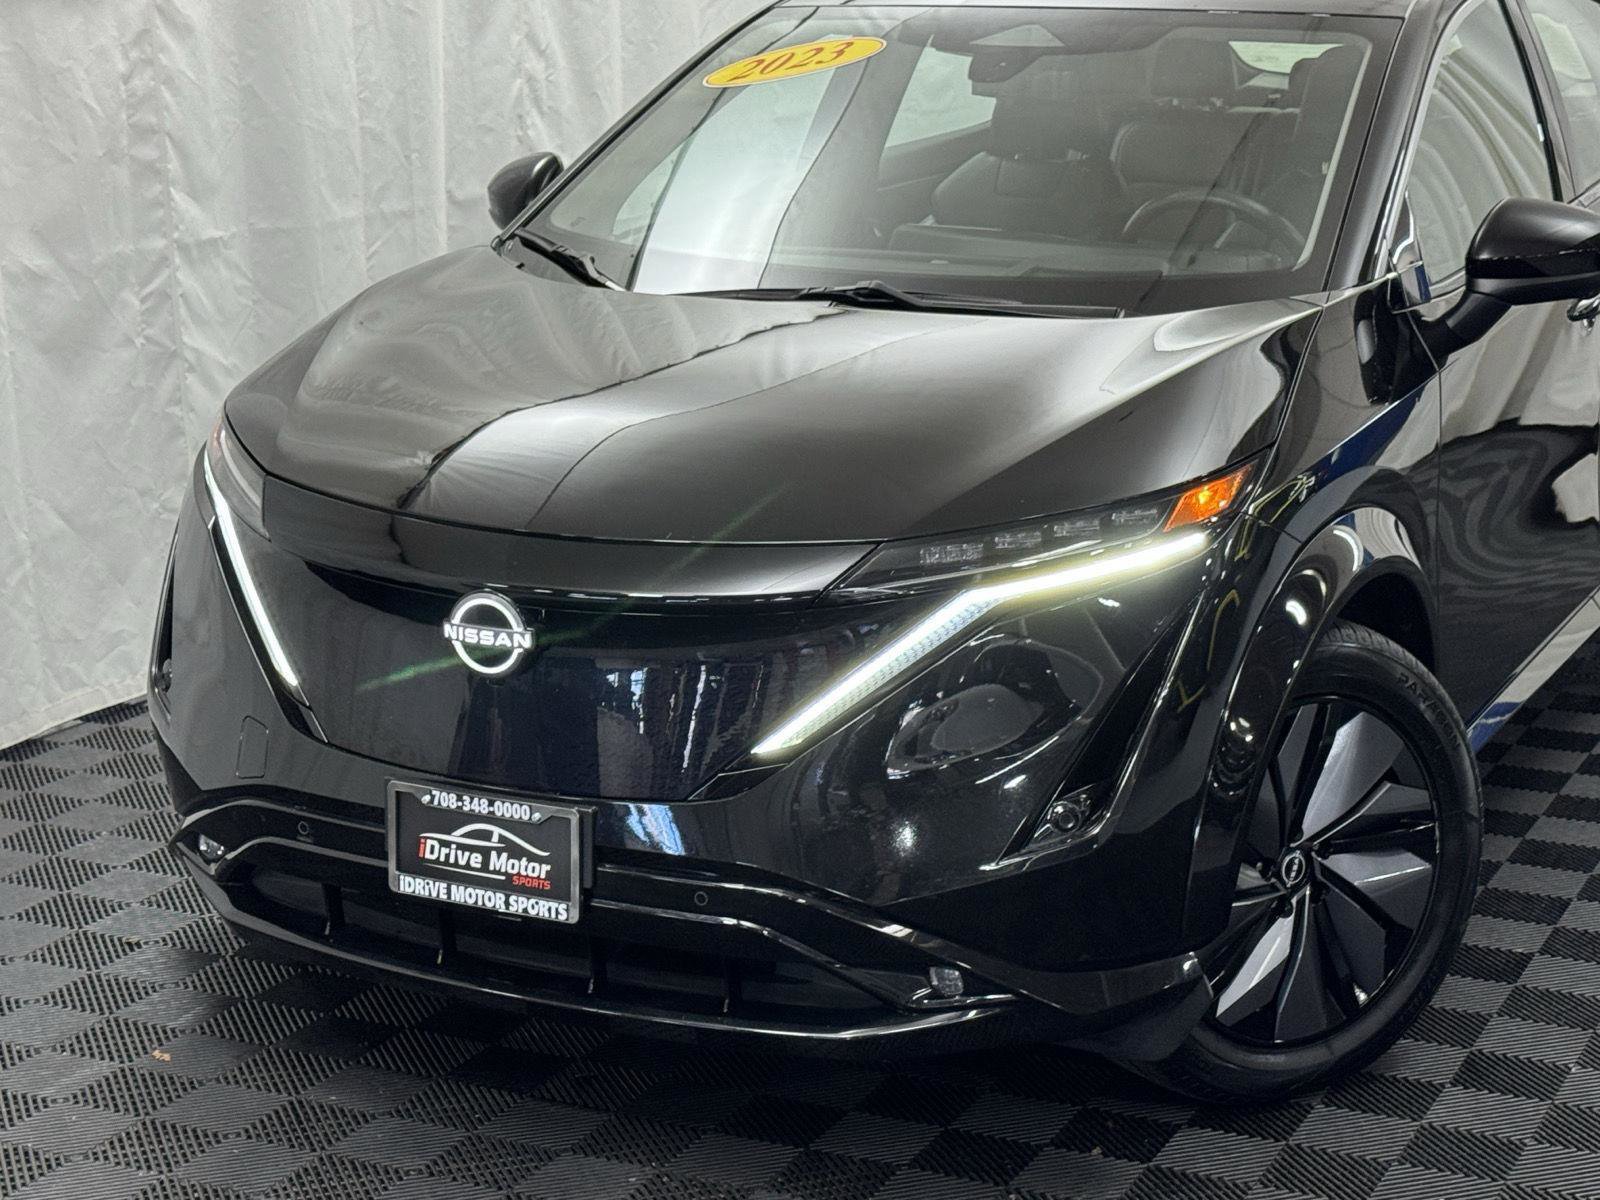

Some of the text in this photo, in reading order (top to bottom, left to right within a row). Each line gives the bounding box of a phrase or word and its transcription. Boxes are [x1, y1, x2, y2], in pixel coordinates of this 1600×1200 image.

[726, 42, 854, 82] 2023
[443, 623, 532, 649] NISSAN
[431, 790, 531, 821] 708-348-0000
[418, 838, 551, 879] iDrive Motor
[512, 875, 551, 890] SPORTS
[450, 885, 506, 911] MOTOR
[508, 896, 568, 920] SPORTS
